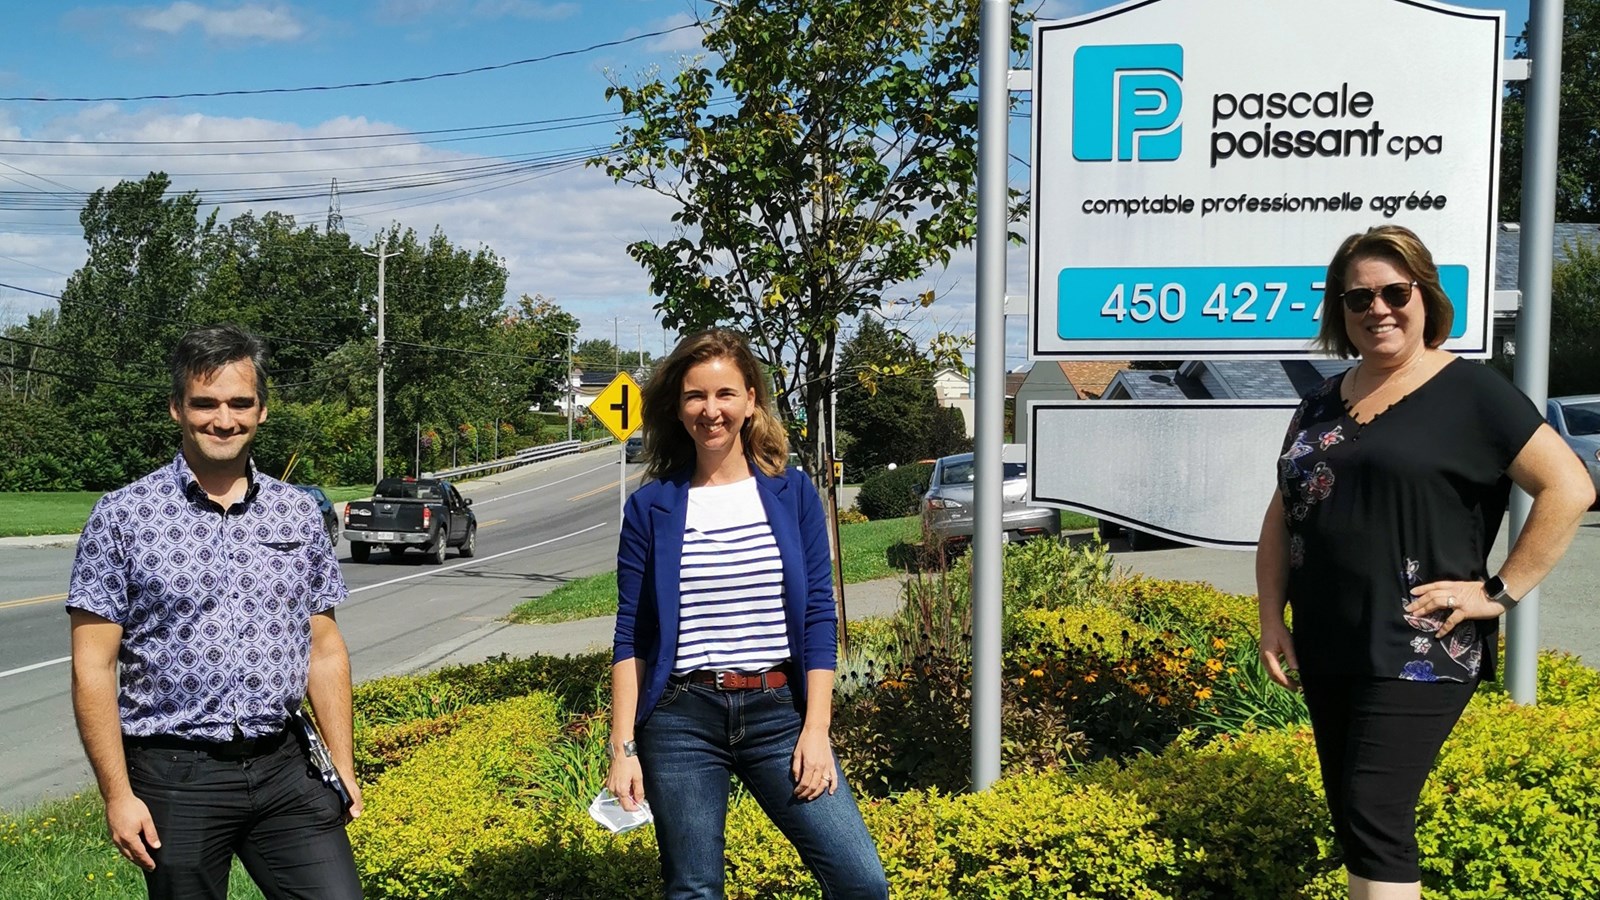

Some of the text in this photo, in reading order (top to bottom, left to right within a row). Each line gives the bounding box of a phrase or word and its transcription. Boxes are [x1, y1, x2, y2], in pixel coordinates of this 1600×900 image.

[1212, 83, 1374, 128] pascale
[1210, 121, 1443, 168] poissant cpa
[1081, 190, 1447, 219] comptable professionnelle agréée
[1100, 283, 1187, 322] 450
